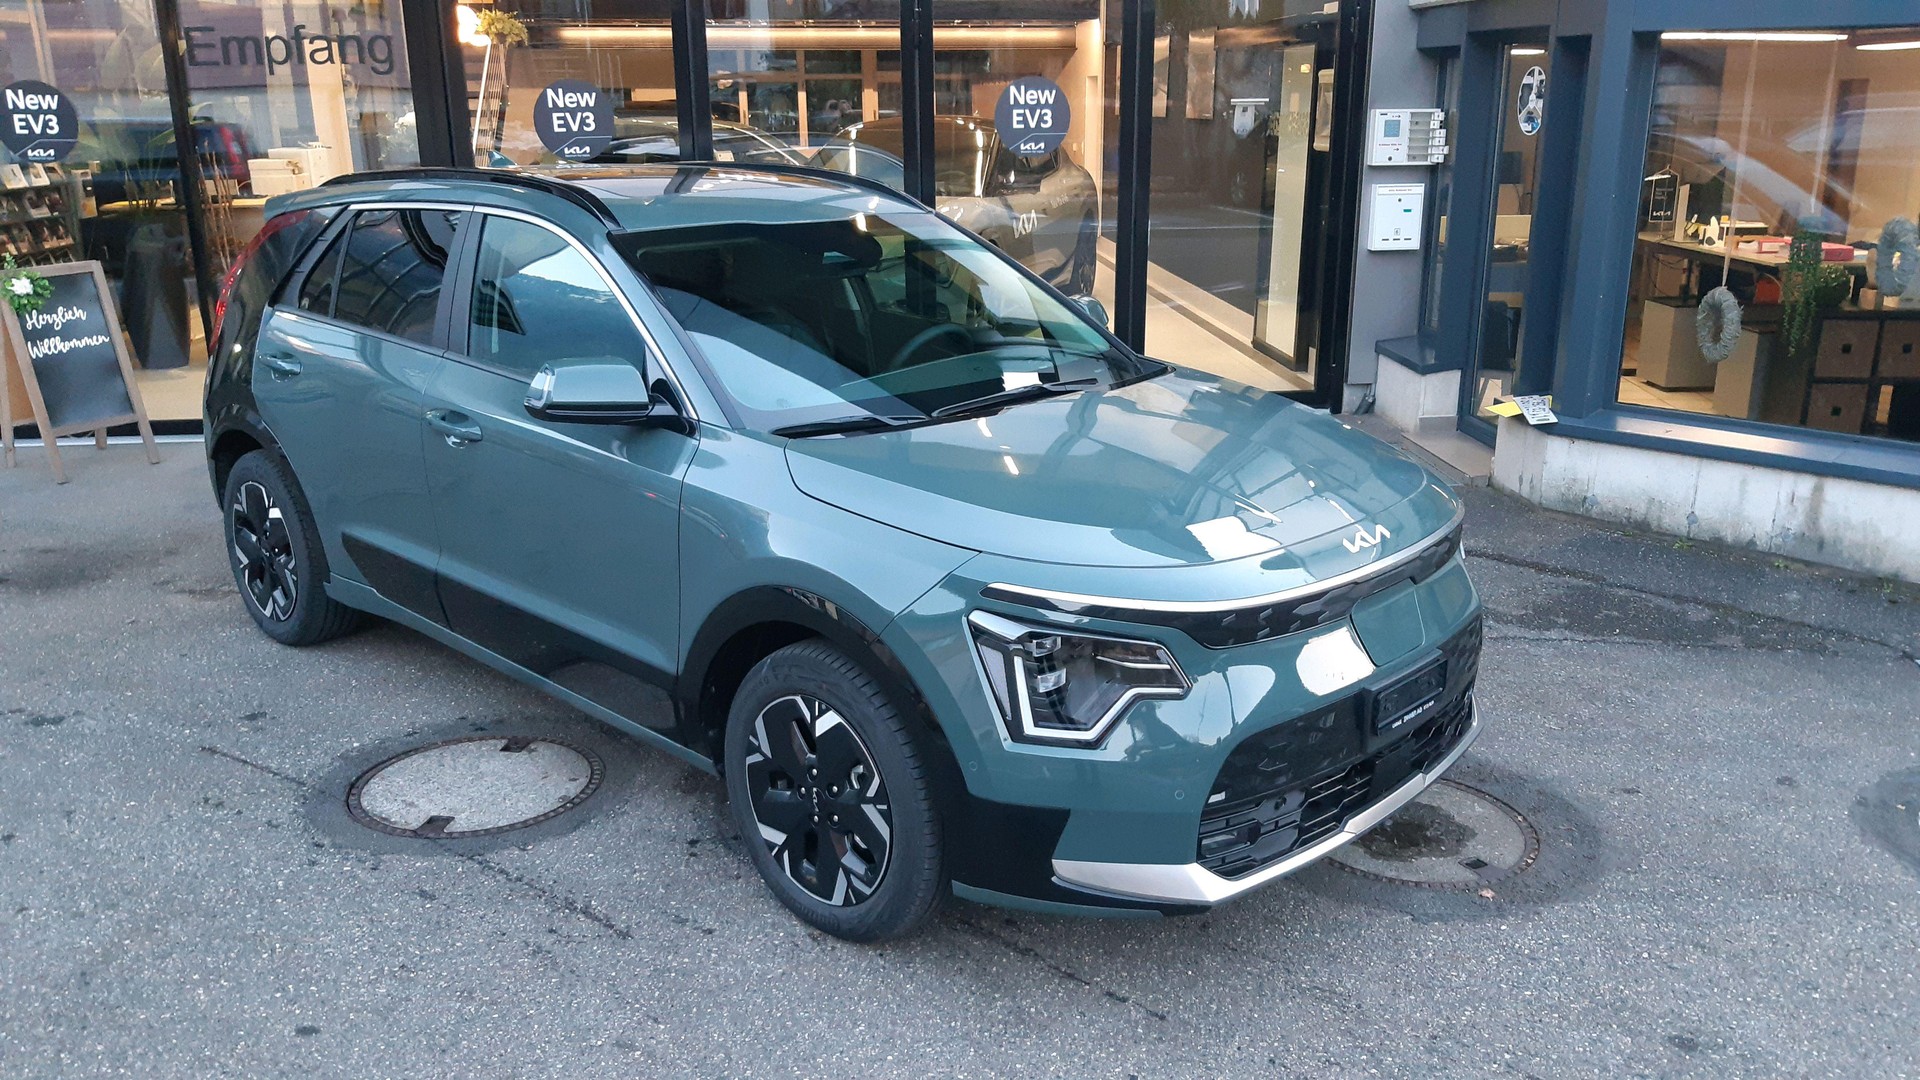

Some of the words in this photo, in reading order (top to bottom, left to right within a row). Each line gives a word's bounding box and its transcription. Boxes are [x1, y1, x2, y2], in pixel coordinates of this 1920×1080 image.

[183, 24, 395, 75] Empfang
[5, 89, 58, 110] New
[546, 88, 597, 108] New
[1009, 85, 1056, 105] New
[13, 114, 60, 134] EV3
[552, 112, 596, 132] EV3
[1012, 109, 1053, 129] EV3
[27, 149, 55, 157] KIA
[564, 146, 590, 154] KIA
[1020, 142, 1045, 150] KIA
[25, 306, 87, 331] Herzlich
[27, 335, 110, 359] Willkommen
[1342, 524, 1391, 553] KIA
